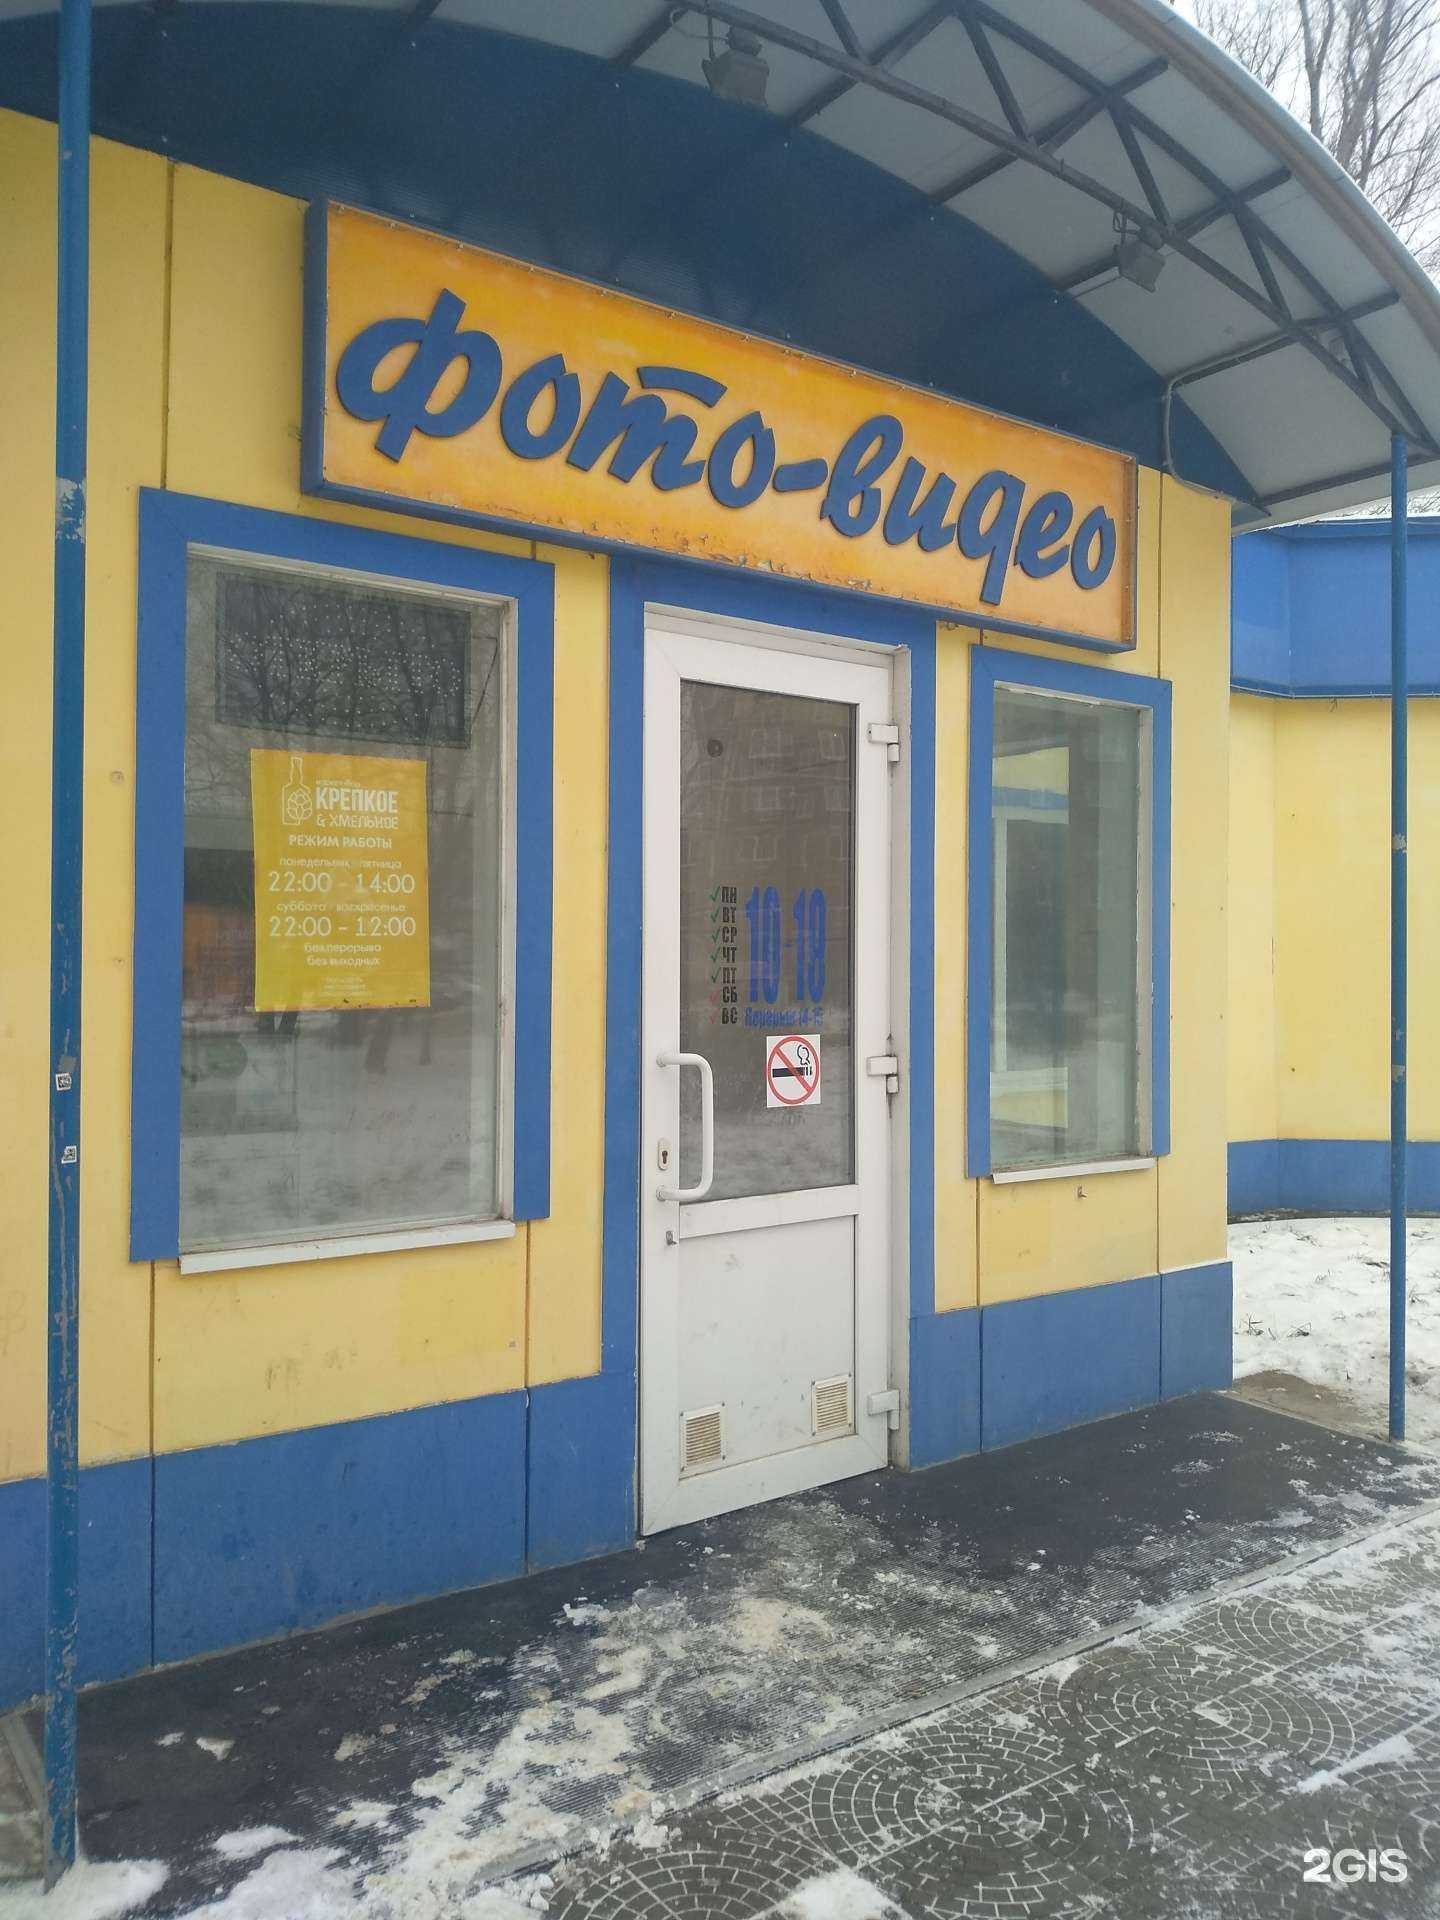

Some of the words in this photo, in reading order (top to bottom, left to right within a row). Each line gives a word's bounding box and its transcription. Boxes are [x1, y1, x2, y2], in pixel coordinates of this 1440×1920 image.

[316, 787, 398, 813] КРЕПКОЕ
[316, 814, 326, 828] &
[330, 815, 399, 829] ХМЕЛЬНОЕ
[288, 834, 339, 847] РЕЖИМ
[342, 837, 392, 848] РАБОТЫ
[268, 871, 332, 892] 22:00
[355, 873, 416, 893] 14:00
[721, 886, 737, 904] ПН
[722, 906, 737, 923] ВТ
[269, 916, 332, 936] 22:00
[355, 916, 417, 937] 12:00
[722, 926, 738, 943] СР
[722, 946, 737, 963] ЧТ
[722, 967, 737, 984] ПТ
[722, 986, 738, 1003] СБ
[722, 1006, 738, 1025] ВС
